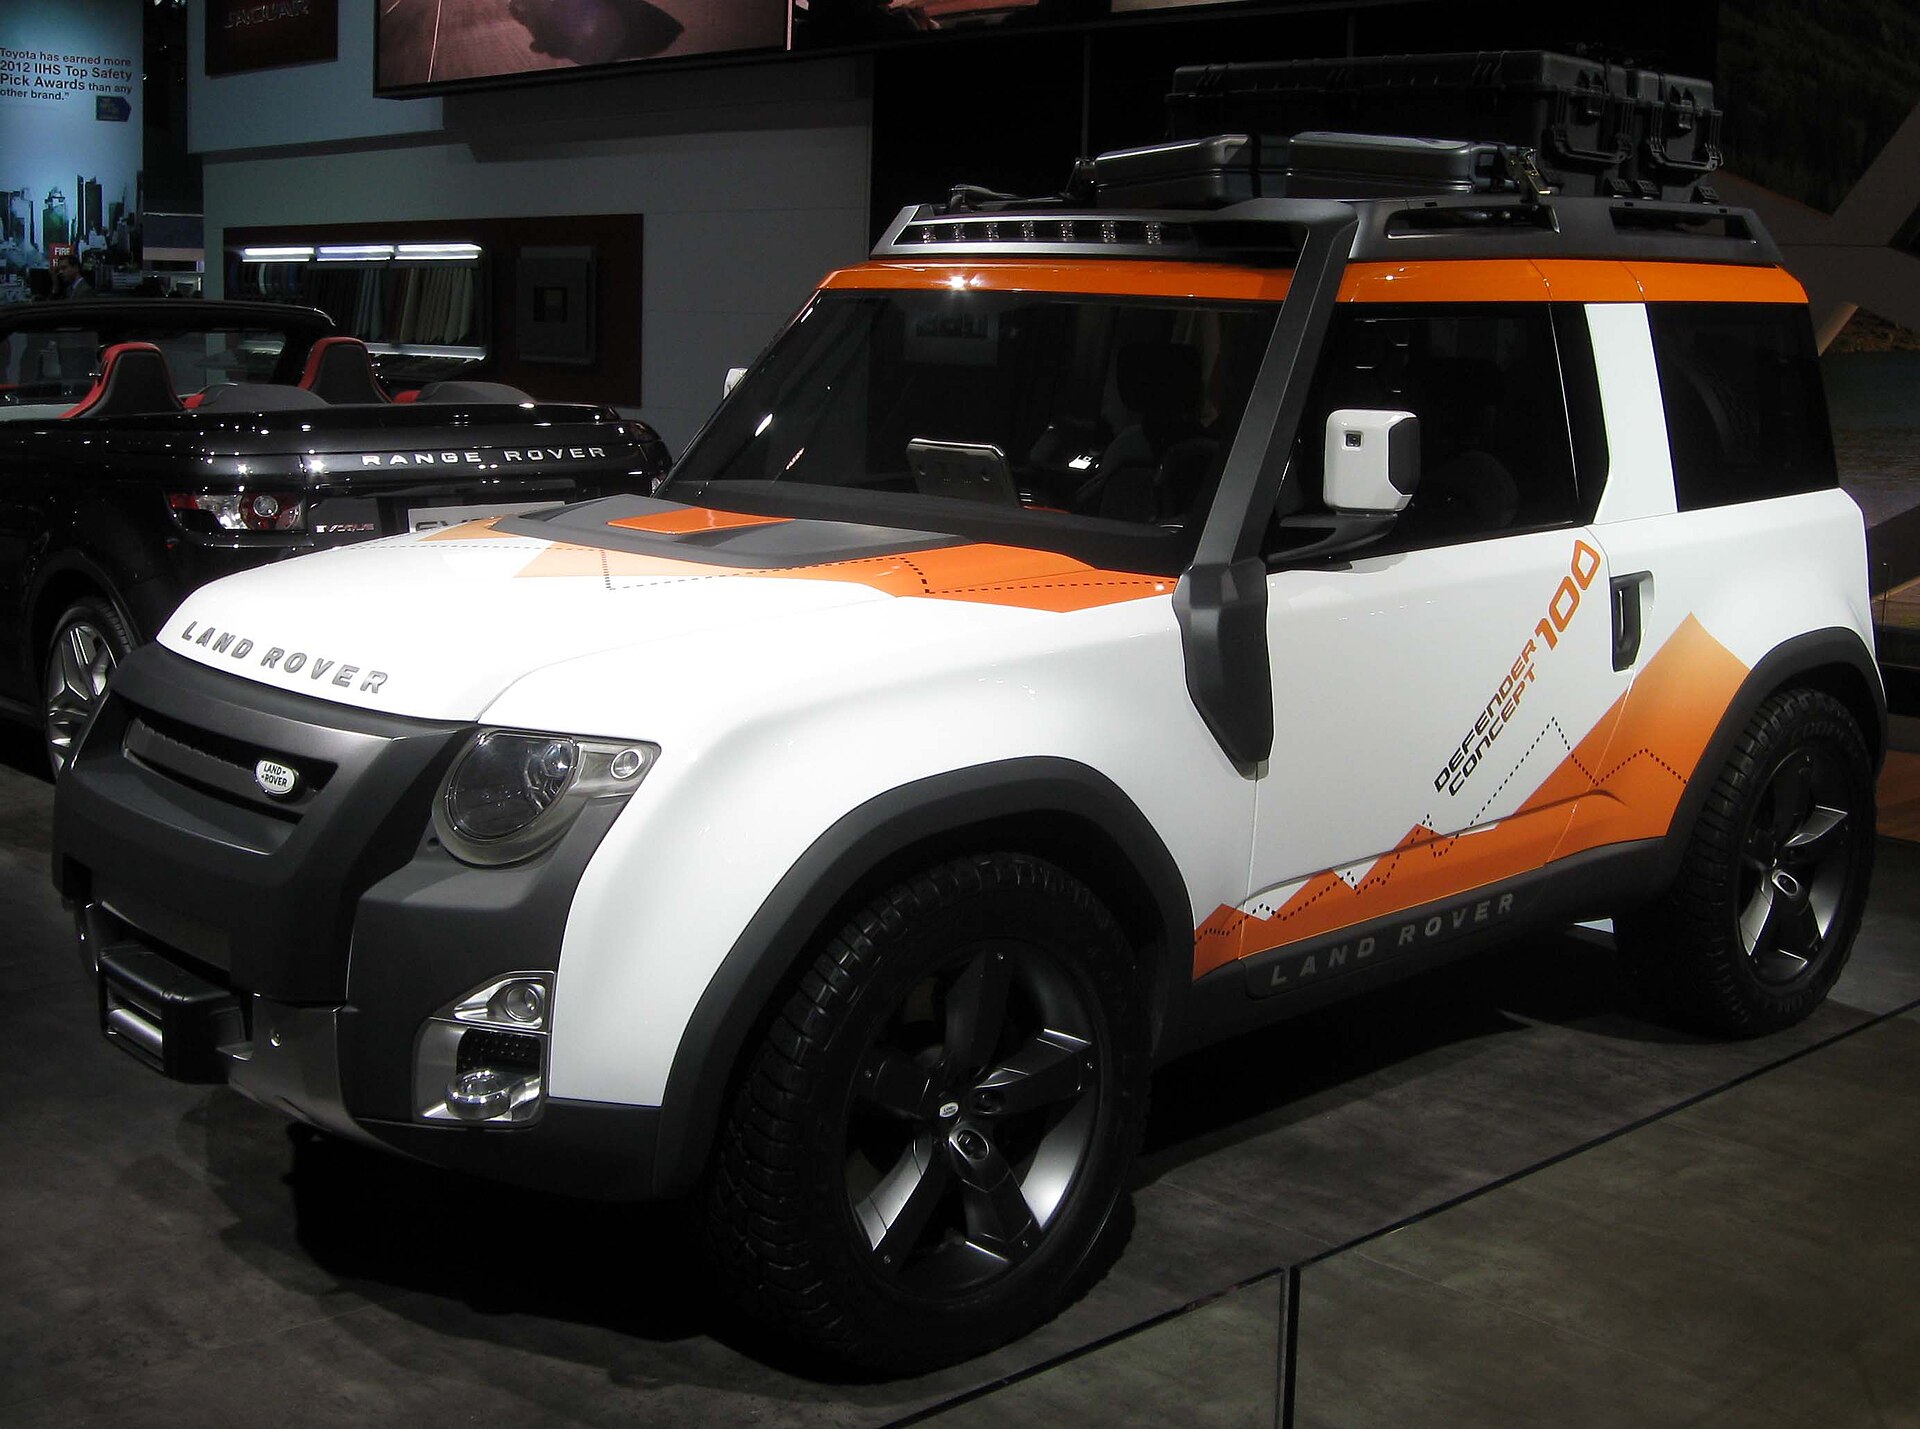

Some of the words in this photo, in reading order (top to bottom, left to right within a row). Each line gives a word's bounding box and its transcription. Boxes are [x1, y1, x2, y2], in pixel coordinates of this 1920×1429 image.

[0, 48, 36, 60] Toyota
[40, 52, 60, 61] has
[63, 56, 101, 65] earned
[104, 58, 132, 67] more
[0, 61, 31, 73] 2012
[35, 63, 61, 75] IIHS
[65, 66, 88, 79] Top
[92, 67, 132, 82] Safety
[0, 73, 30, 86] Pick
[34, 76, 85, 90] Awards
[89, 83, 111, 92] than
[114, 85, 133, 95] any
[0, 89, 28, 98] other
[361, 451, 482, 466] RANGE
[503, 447, 606, 462] ROVER
[181, 620, 254, 660] LAND
[260, 646, 388, 694] ROVER
[1434, 639, 1537, 793] DEFENDER
[1535, 539, 1601, 650] 100
[1448, 663, 1536, 797] CONCEPT
[1270, 937, 1376, 986] LAND
[1398, 893, 1514, 946] ROVER
